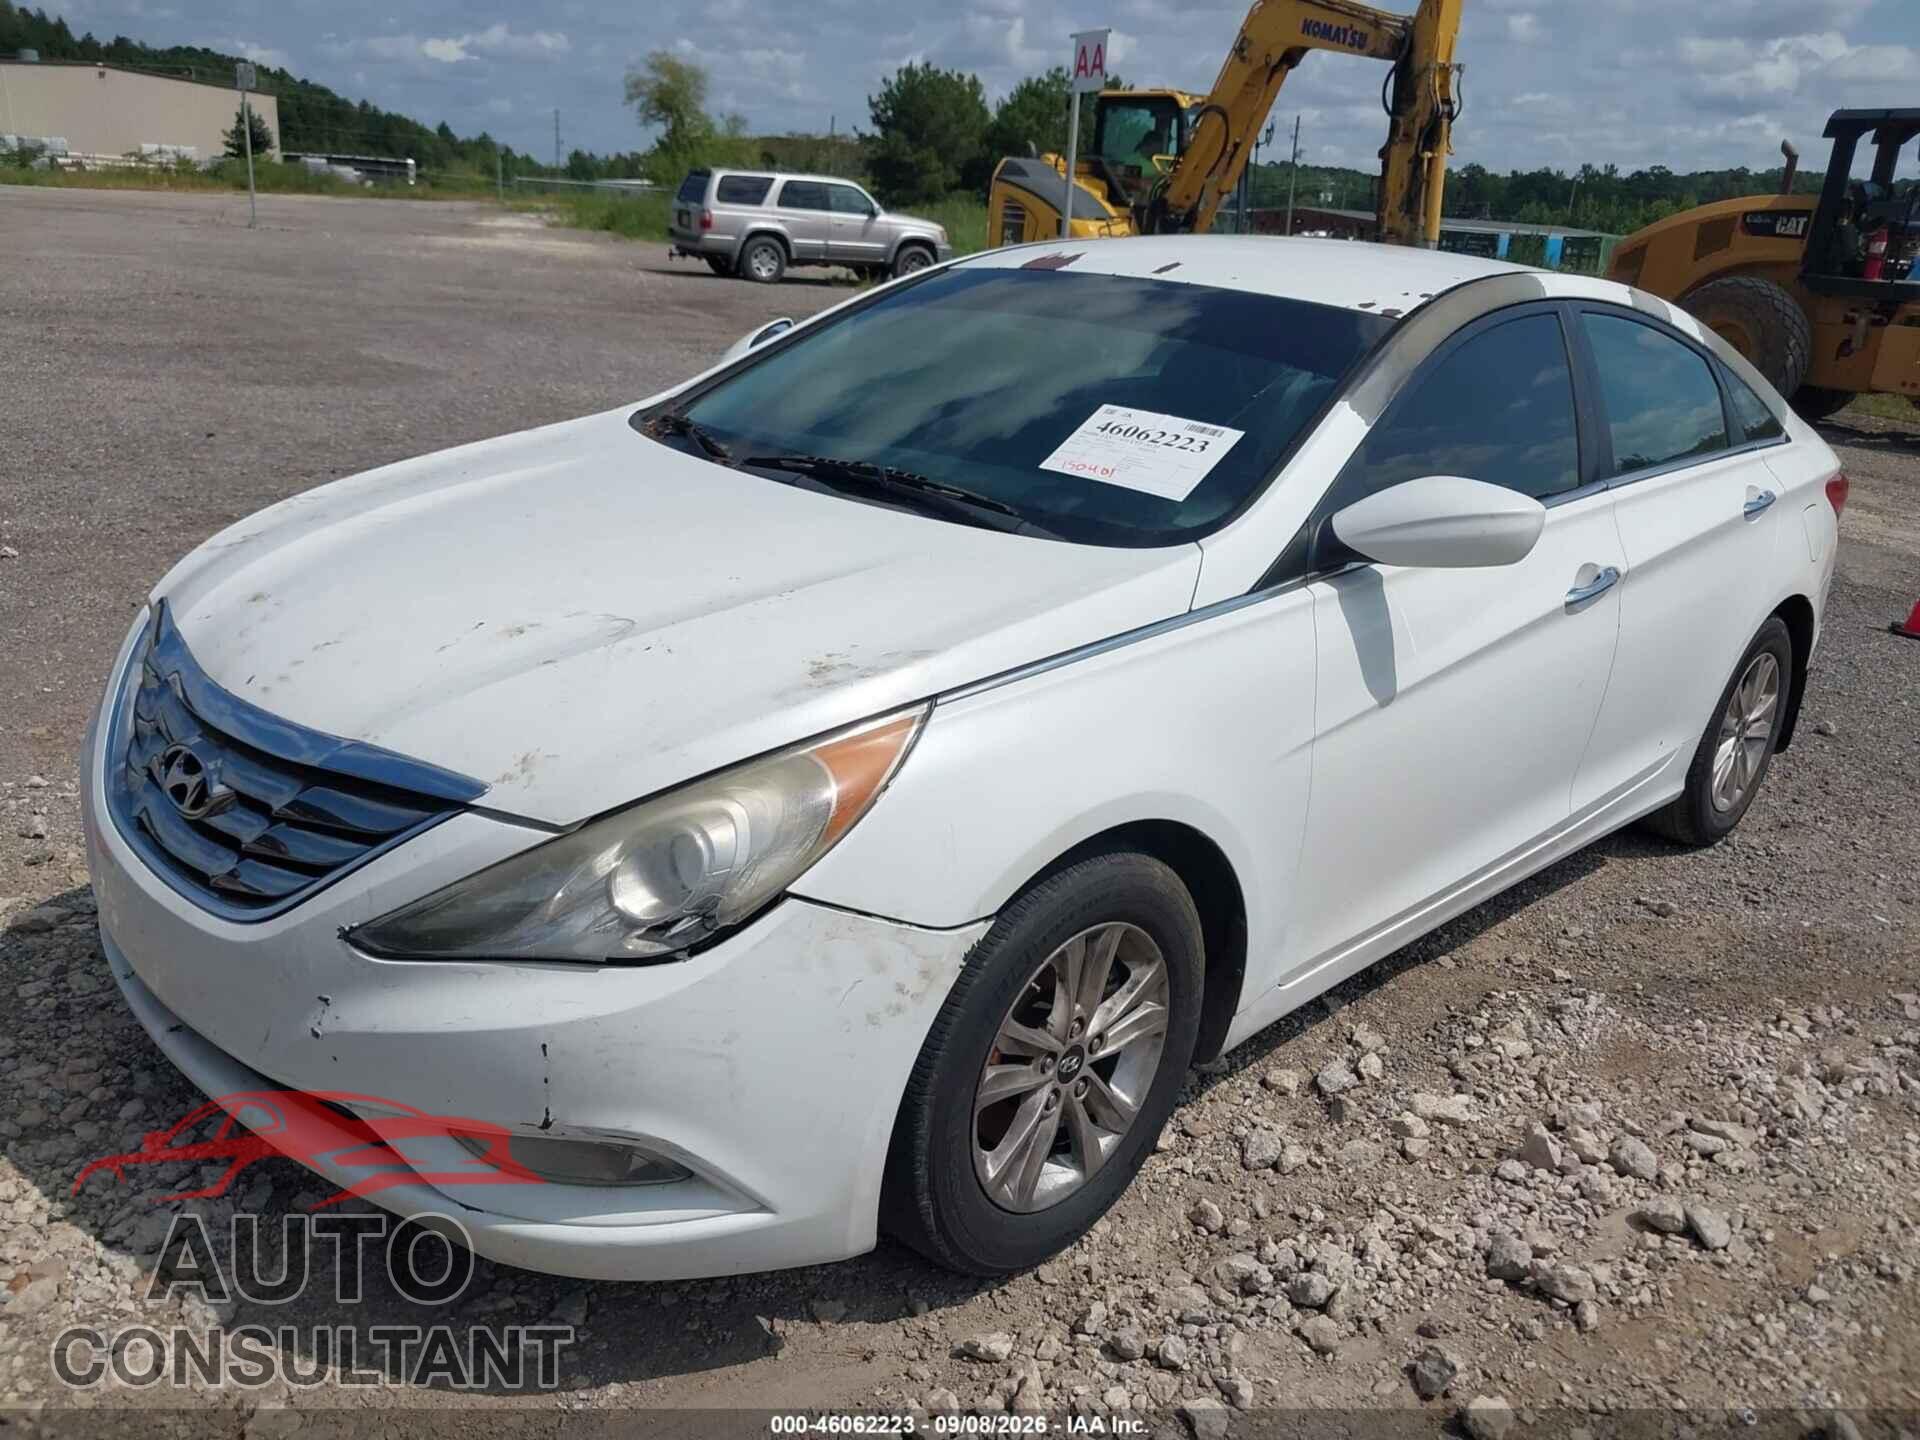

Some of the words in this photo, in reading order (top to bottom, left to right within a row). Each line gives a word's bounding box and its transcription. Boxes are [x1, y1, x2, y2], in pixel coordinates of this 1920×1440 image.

[1301, 18, 1368, 49] KOMATSU
[1074, 43, 1104, 79] AA
[1776, 216, 1808, 235] CAT
[1096, 420, 1210, 453] 46062223
